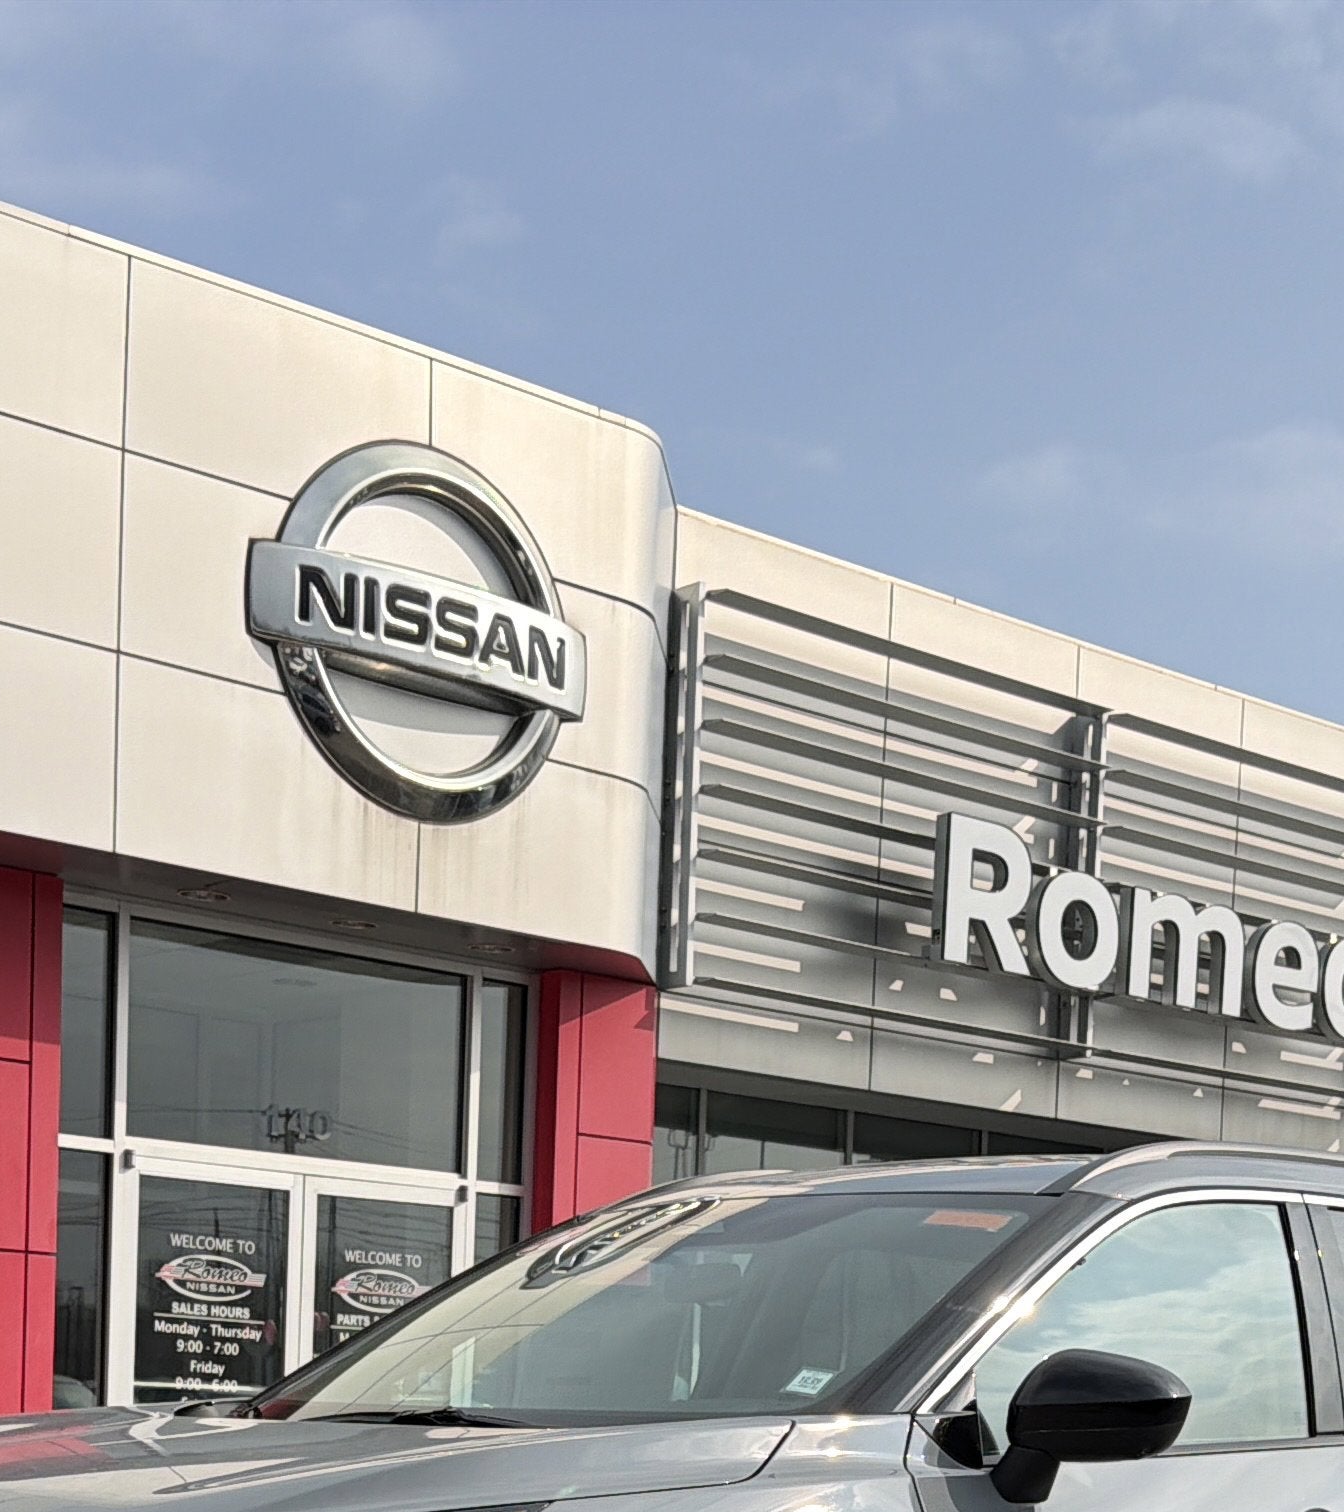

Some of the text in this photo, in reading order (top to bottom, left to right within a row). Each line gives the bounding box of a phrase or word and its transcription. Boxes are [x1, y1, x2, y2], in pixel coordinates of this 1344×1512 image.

[297, 563, 566, 697] NISSAN
[169, 1232, 256, 1255] WELCOME TO
[344, 1249, 422, 1268] WELCOME TO
[176, 1257, 248, 1282] Romeo
[186, 1281, 236, 1295] NISSAN
[351, 1271, 416, 1295] Romeo
[359, 1295, 405, 1306] NISSAN
[171, 1301, 251, 1319] SALES HOURS
[336, 1313, 371, 1327] PARTS
[154, 1320, 200, 1338] Monday
[210, 1324, 263, 1342] Thursday
[176, 1339, 203, 1353] 9:00
[213, 1341, 240, 1356] 7:00
[190, 1360, 226, 1377] Friday
